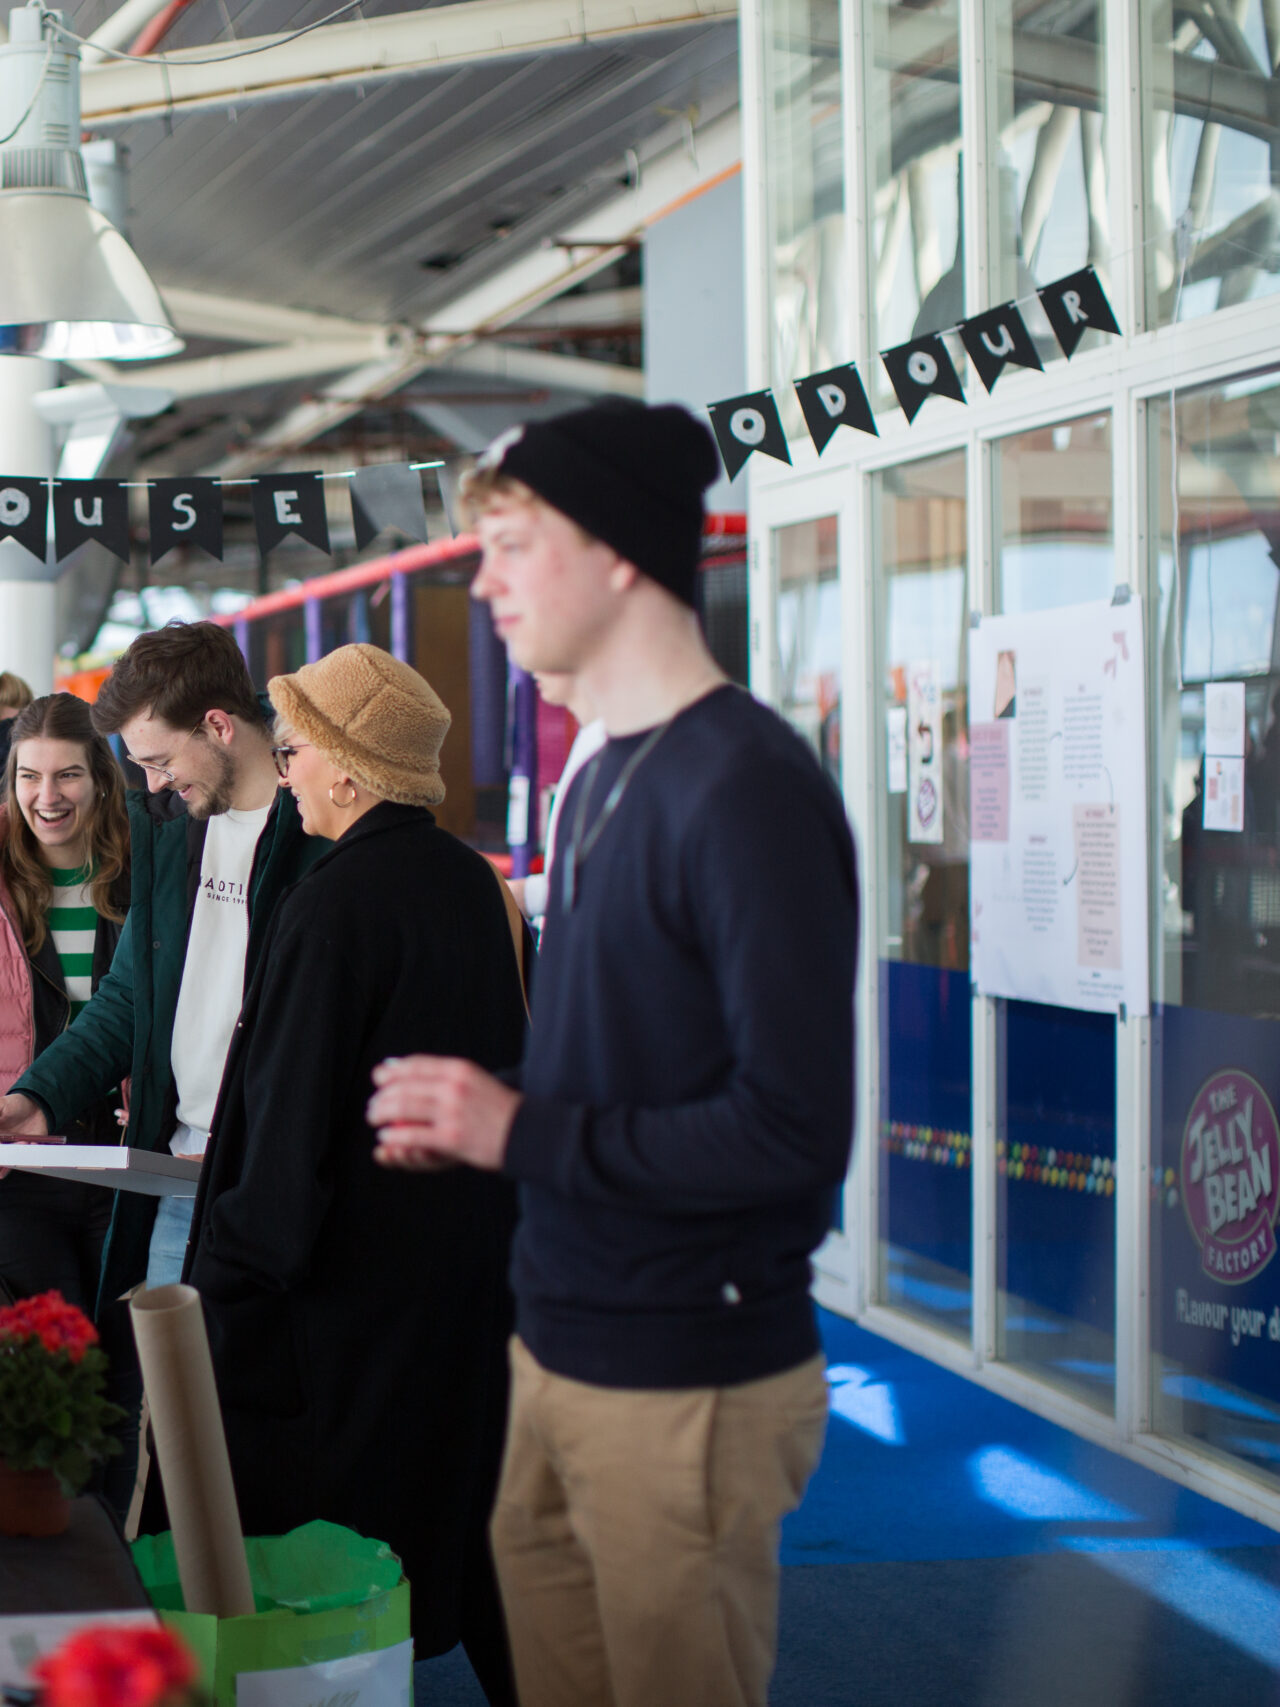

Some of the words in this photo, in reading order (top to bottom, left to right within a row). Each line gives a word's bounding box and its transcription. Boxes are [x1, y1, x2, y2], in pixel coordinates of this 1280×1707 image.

[730, 290, 1088, 446] ODOUR
[201, 877, 243, 896] AOTI
[206, 892, 230, 903] SINCE
[1209, 1084, 1238, 1114] THE
[1188, 1096, 1255, 1185] JELLY
[1205, 1143, 1272, 1234] BEAN
[1207, 1235, 1268, 1275] FACTORY
[1231, 1306, 1266, 1346] your
